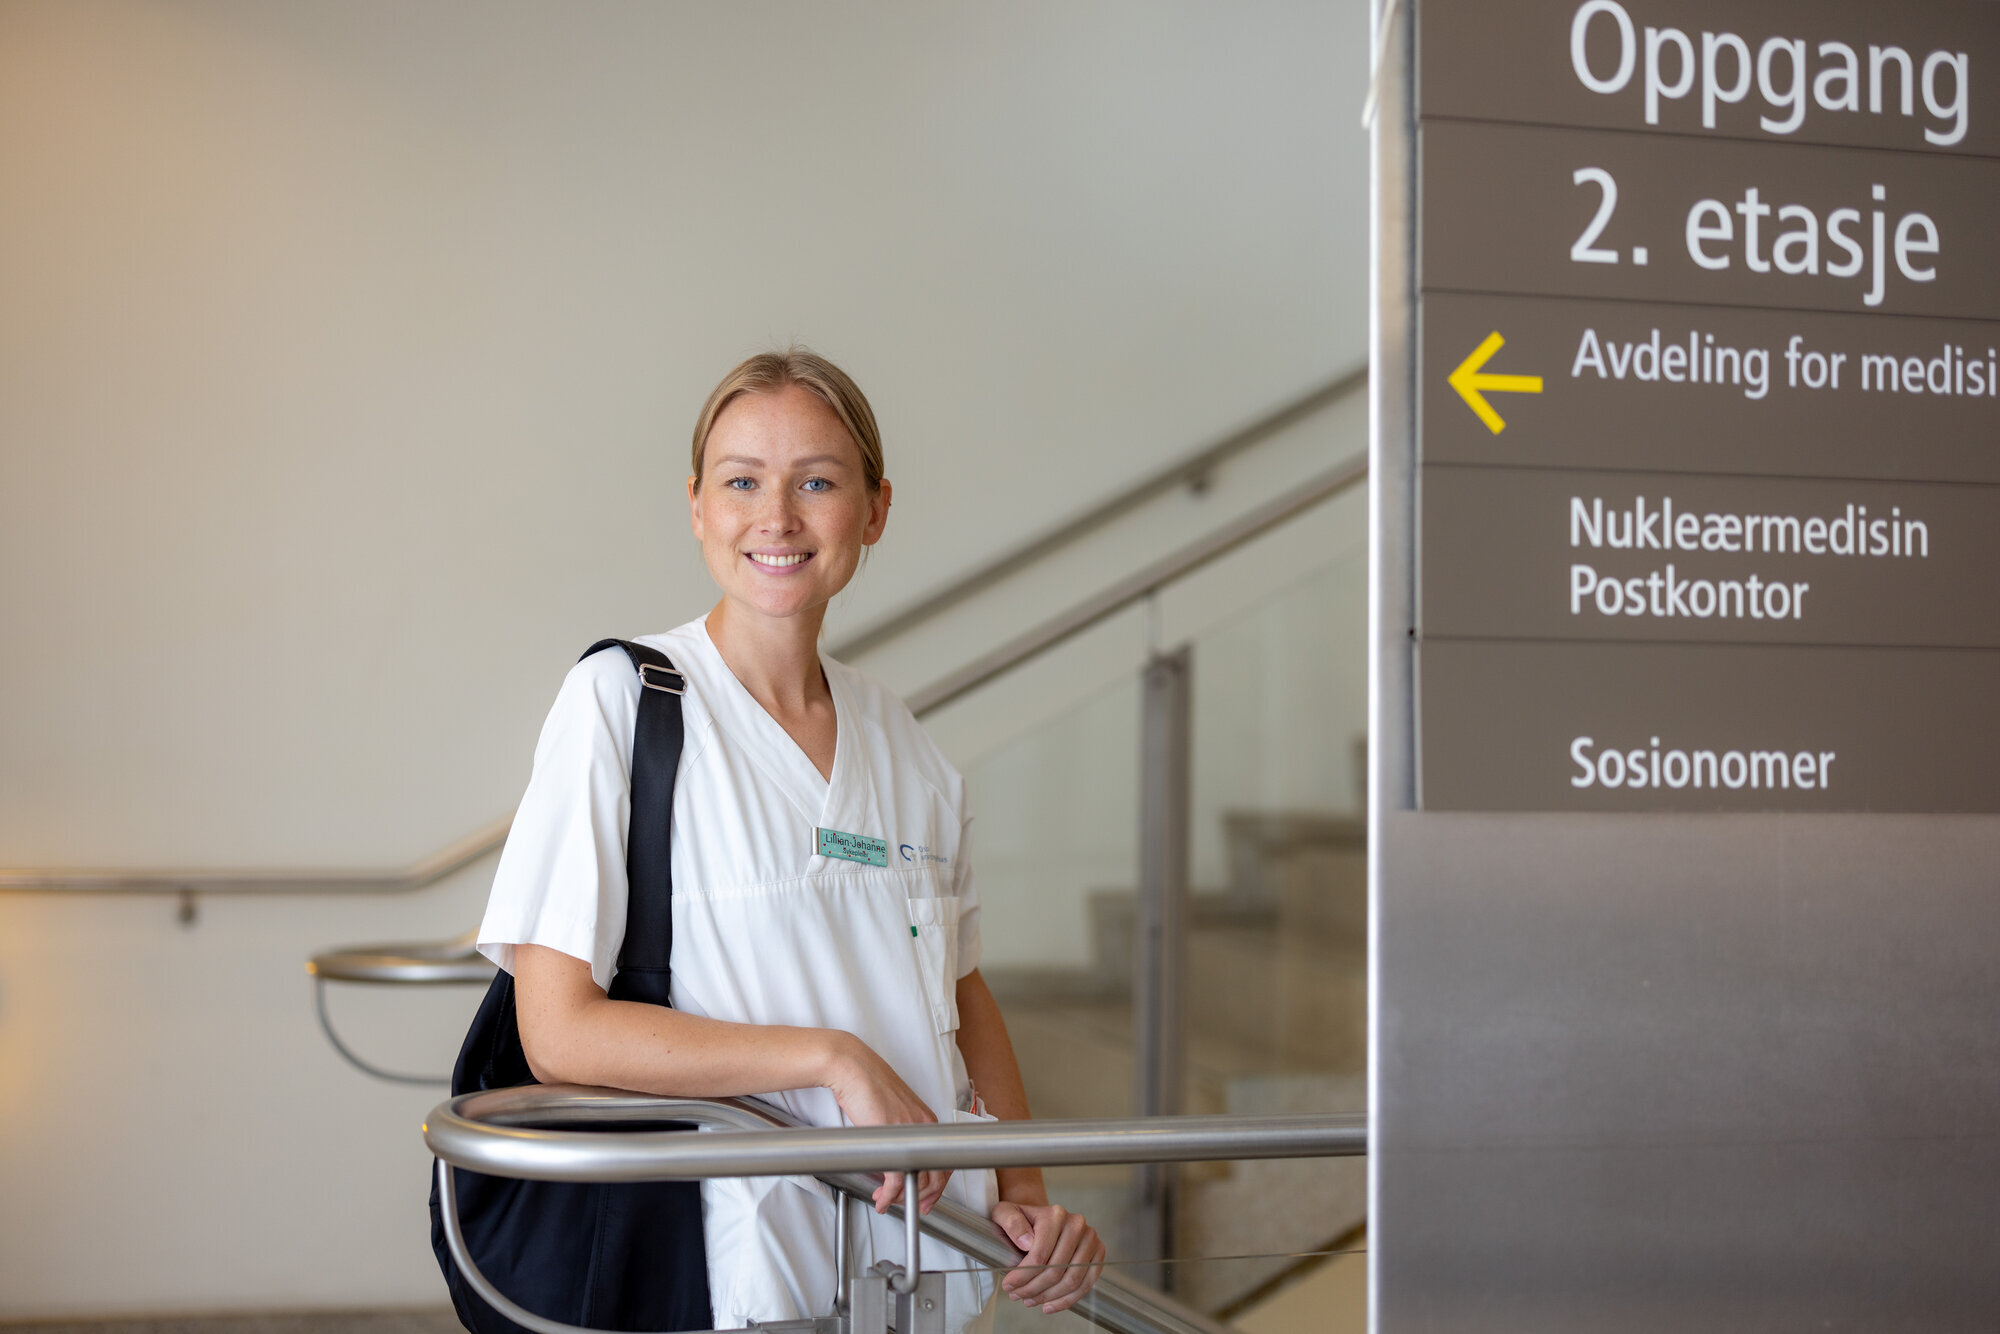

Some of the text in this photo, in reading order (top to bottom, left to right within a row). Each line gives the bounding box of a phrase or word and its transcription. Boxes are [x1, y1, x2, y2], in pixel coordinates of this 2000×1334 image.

[1570, 0, 1969, 146] Oppgang
[1570, 167, 1941, 306] 2. etasje
[1571, 328, 1997, 402] Avdeling for medisi
[1570, 496, 1930, 557] Nukleærmedisin
[1570, 564, 1811, 619] Postkontor
[1570, 736, 1836, 789] Sosionomer
[825, 833, 886, 854] Lillian-Johanne
